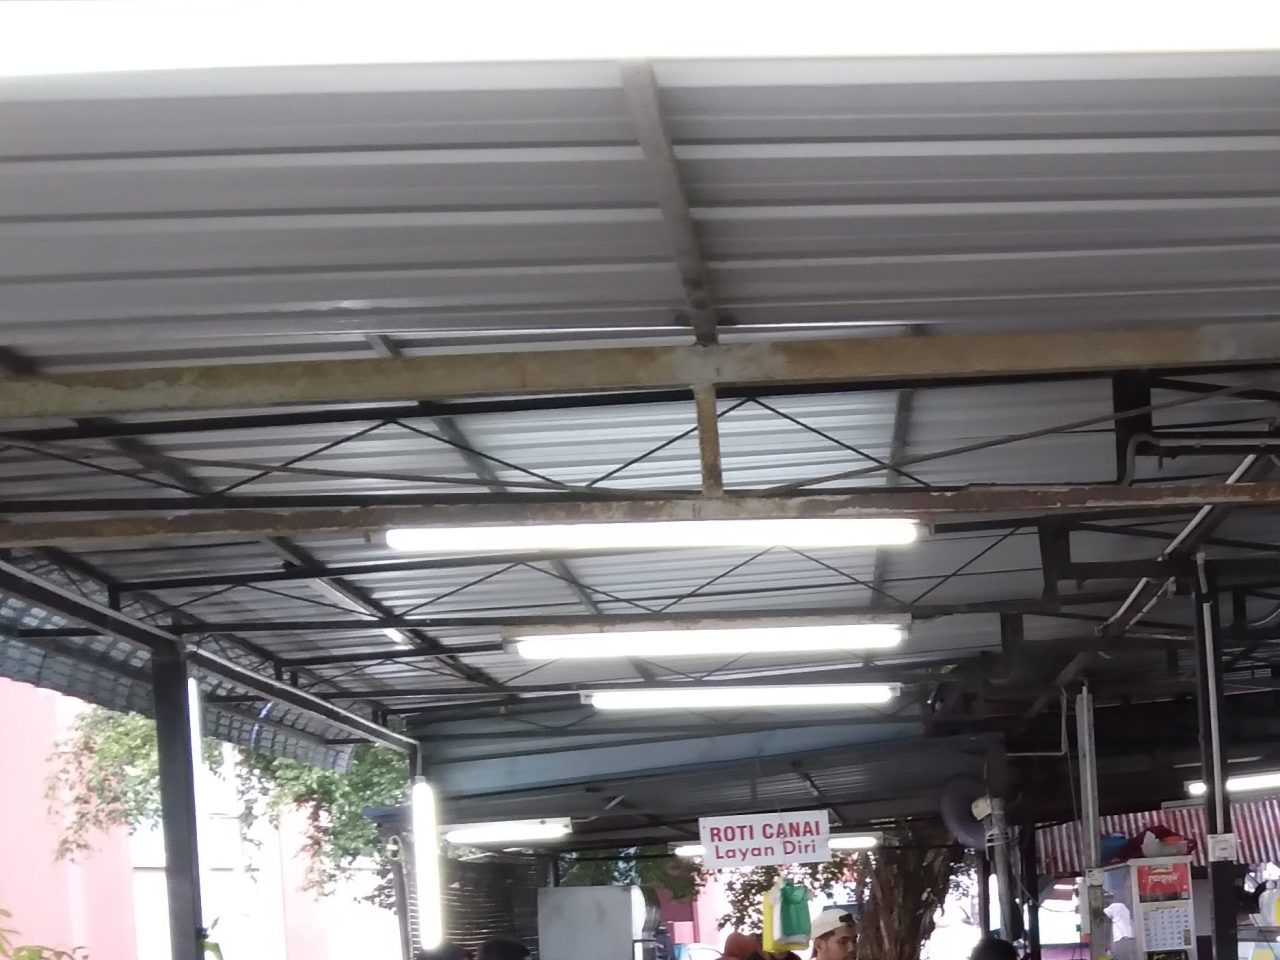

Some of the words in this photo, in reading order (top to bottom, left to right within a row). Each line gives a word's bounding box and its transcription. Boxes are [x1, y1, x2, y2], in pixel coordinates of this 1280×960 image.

[710, 825, 754, 843] ROTI
[762, 820, 821, 839] CANAI
[715, 844, 775, 862] Layan
[783, 840, 816, 856] Diri
